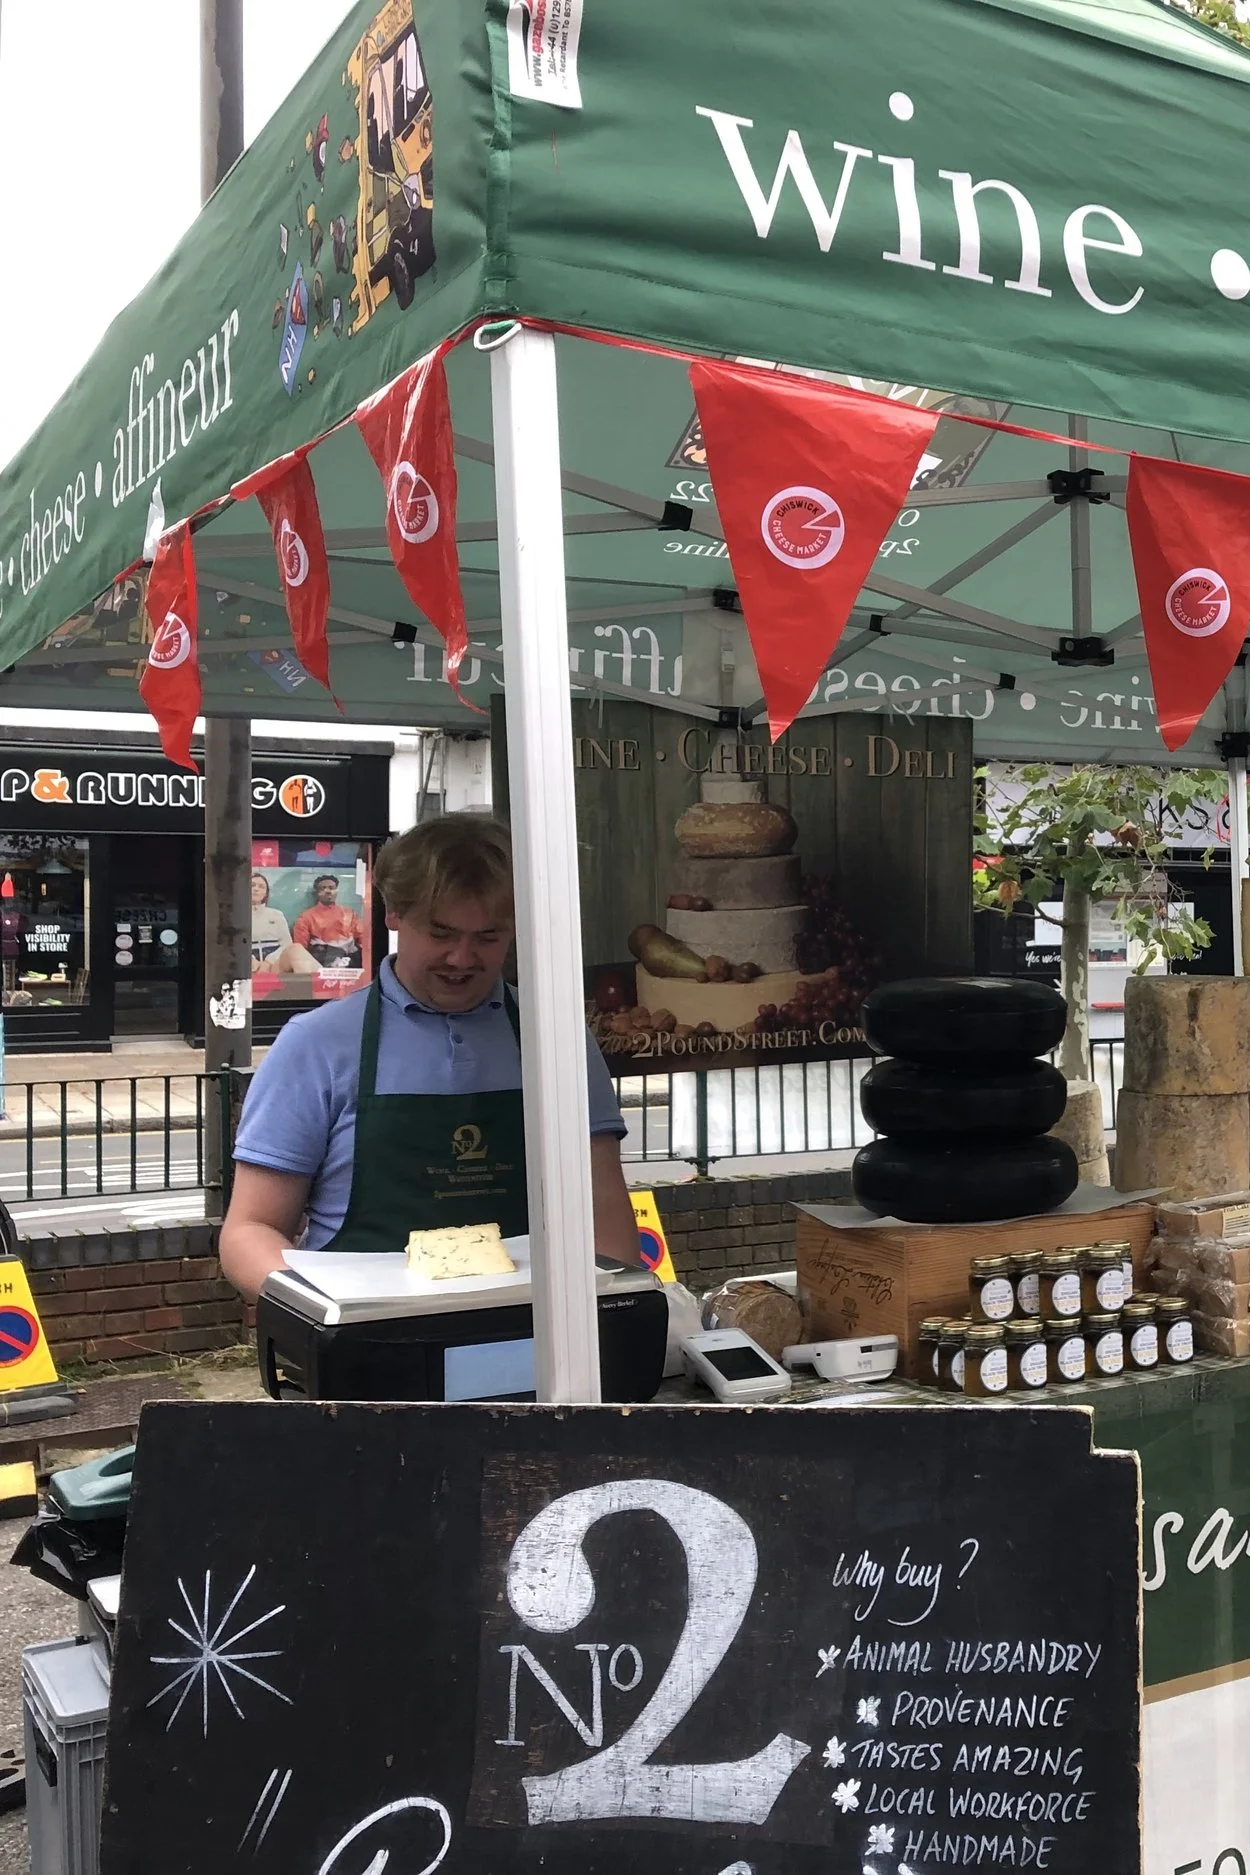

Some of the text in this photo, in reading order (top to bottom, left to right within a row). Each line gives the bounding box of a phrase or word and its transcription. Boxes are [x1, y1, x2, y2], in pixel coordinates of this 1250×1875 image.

[695, 92, 1145, 315] wine
[20, 308, 239, 595] cheese affineur
[777, 500, 820, 518] CHISWICK
[772, 520, 827, 555] CHEESE MARKET
[1178, 580, 1212, 596] CHISWICK
[1174, 597, 1217, 626] CHEESE MARKET
[25, 933, 71, 943] VISIBILITY
[28, 942, 68, 952] IN STORE
[35, 924, 61, 934] SHOP
[831, 1549, 885, 1622] Why
[506, 1478, 812, 1826] 2
[842, 1635, 1102, 1678] ANIMAL HUSBANDRY
[891, 1687, 1075, 1729] PROVENANCE
[851, 1739, 1084, 1785] TASTES AMAZING
[864, 1785, 1097, 1823] LOCAL WORKFORCE
[902, 1829, 1059, 1870] HANDMADE
